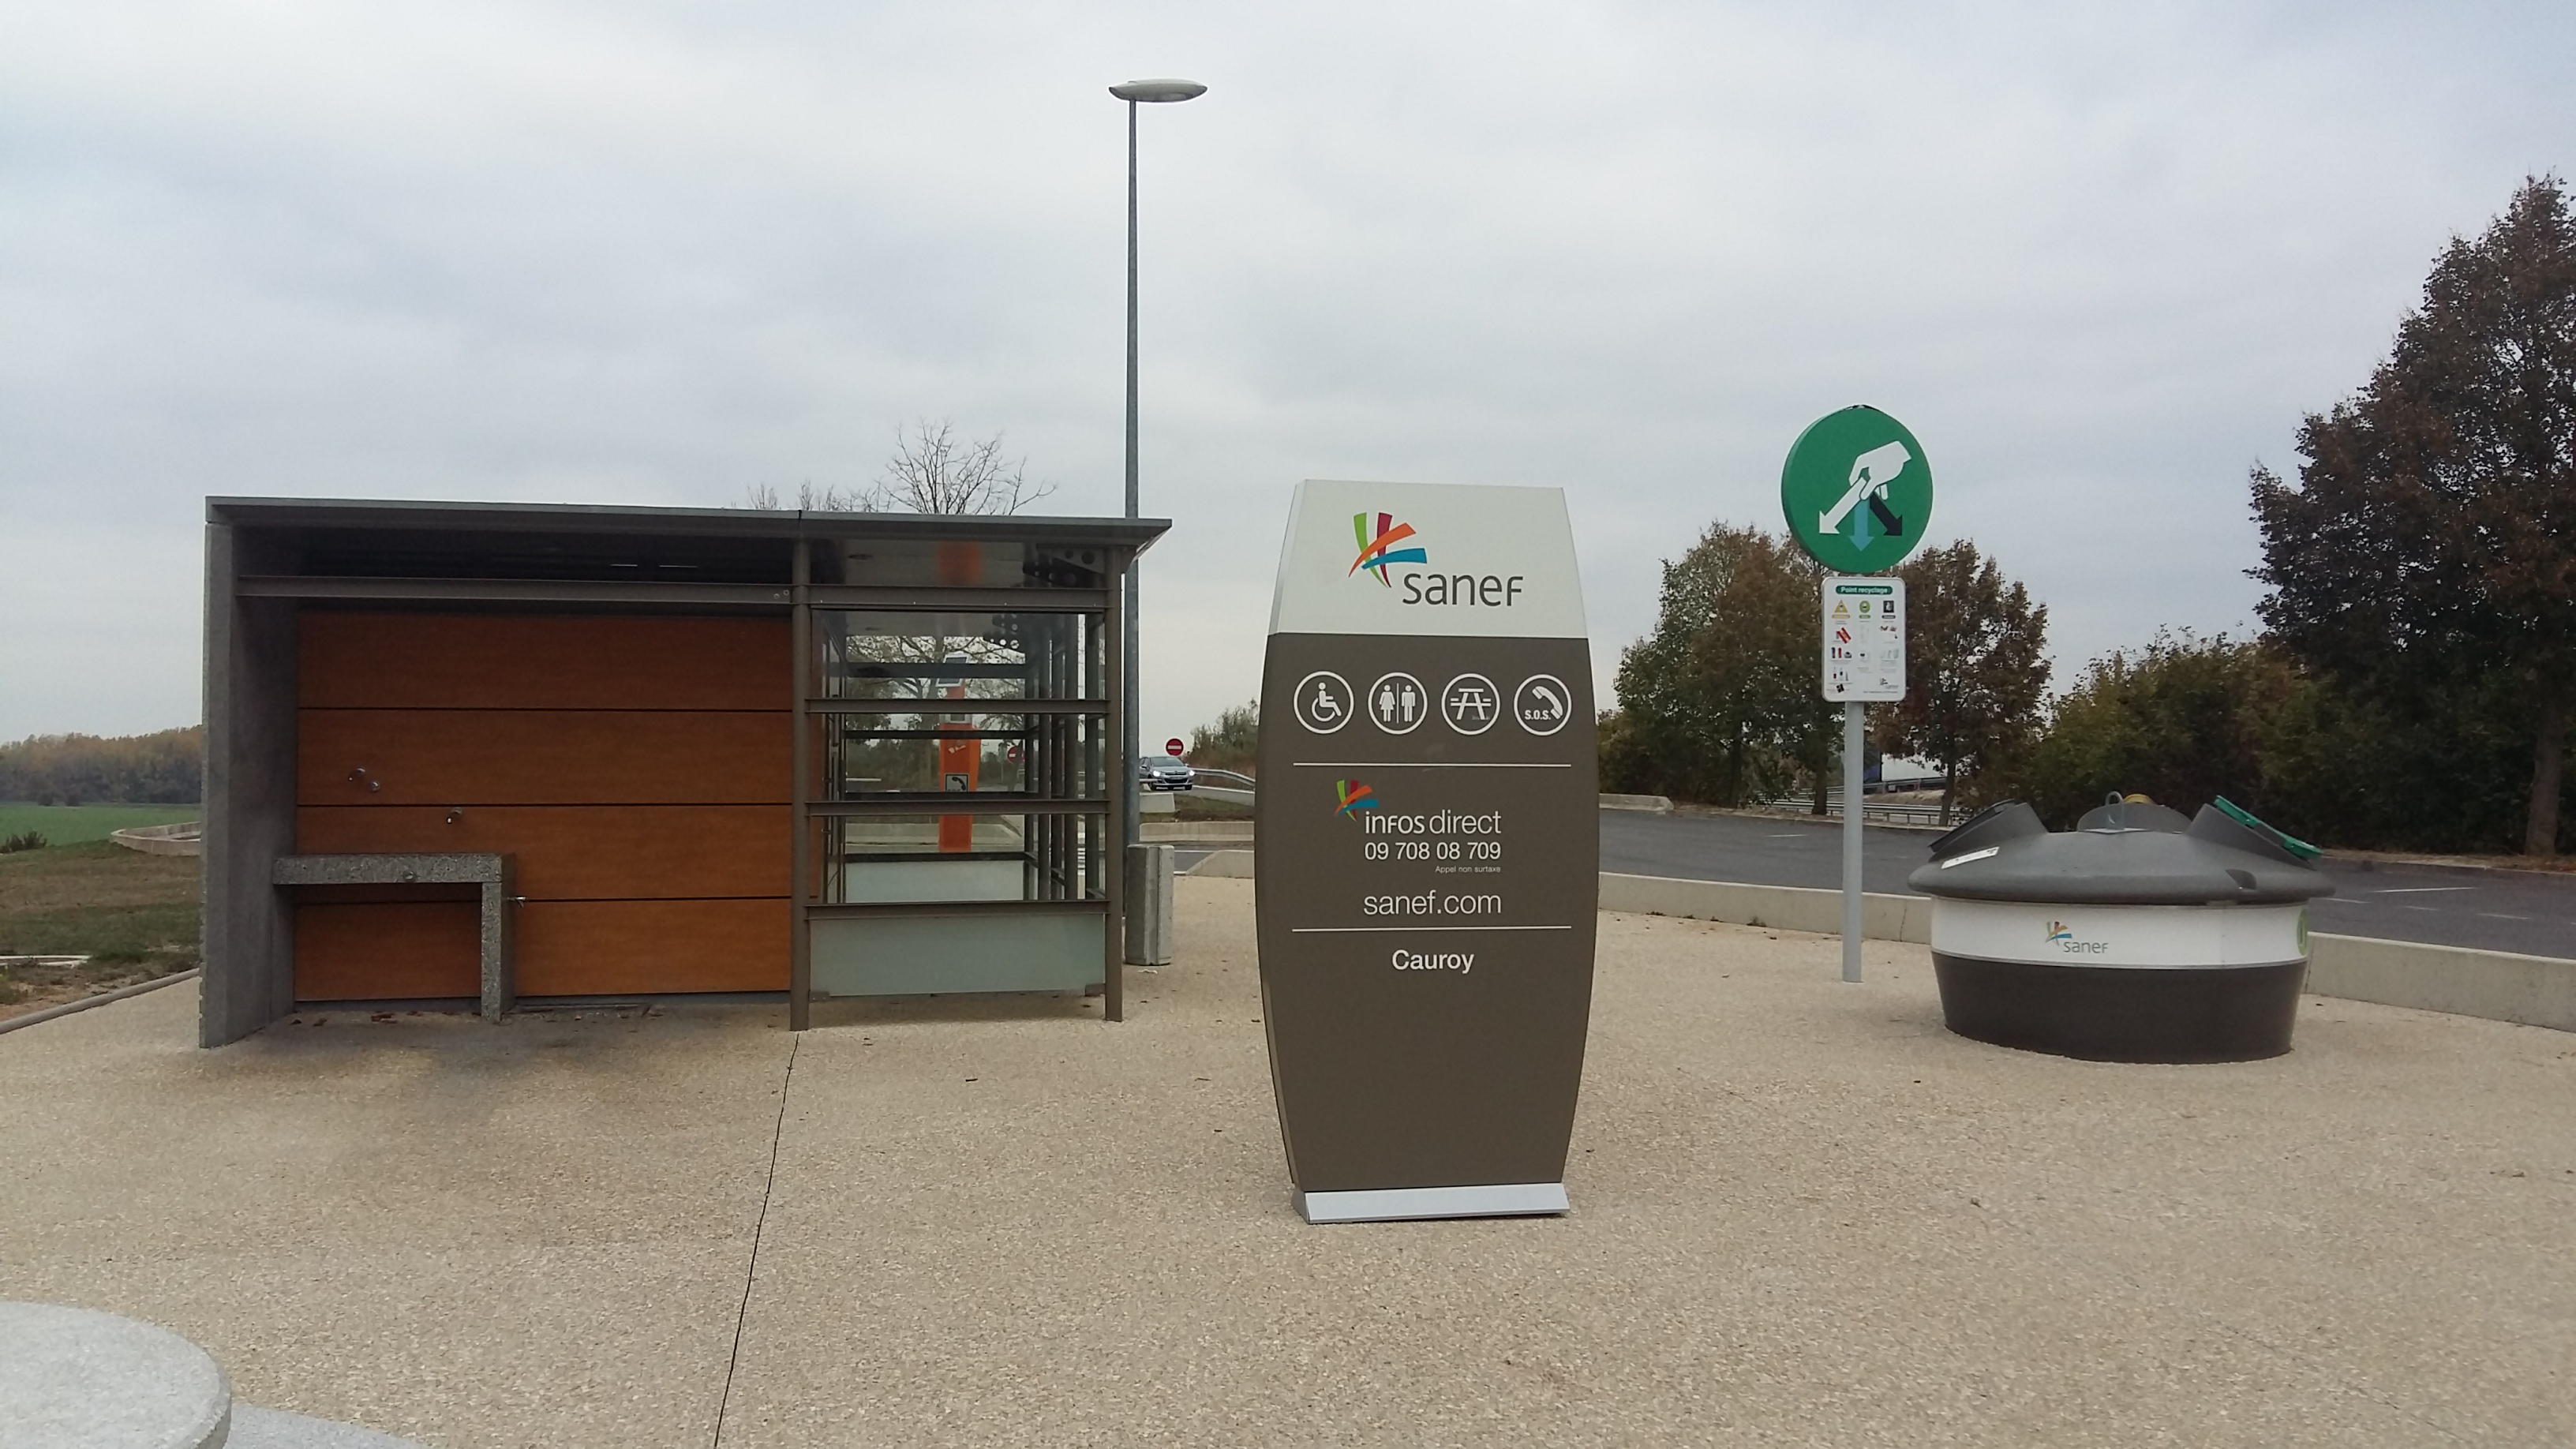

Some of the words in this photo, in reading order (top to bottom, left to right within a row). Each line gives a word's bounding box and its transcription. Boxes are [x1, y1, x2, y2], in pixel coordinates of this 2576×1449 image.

[1402, 573, 1523, 607] sanef
[1365, 811, 1425, 834] infos
[1429, 809, 1502, 834] direct
[1365, 842, 1389, 860] 09
[1395, 842, 1430, 860] 708
[1436, 842, 1460, 860] 08
[1467, 841, 1501, 860] 709
[1435, 866, 1456, 874] Appel
[1363, 889, 1502, 915] sanef.com
[2063, 942, 2109, 954] sanef
[1391, 949, 1475, 974] Cauroy
